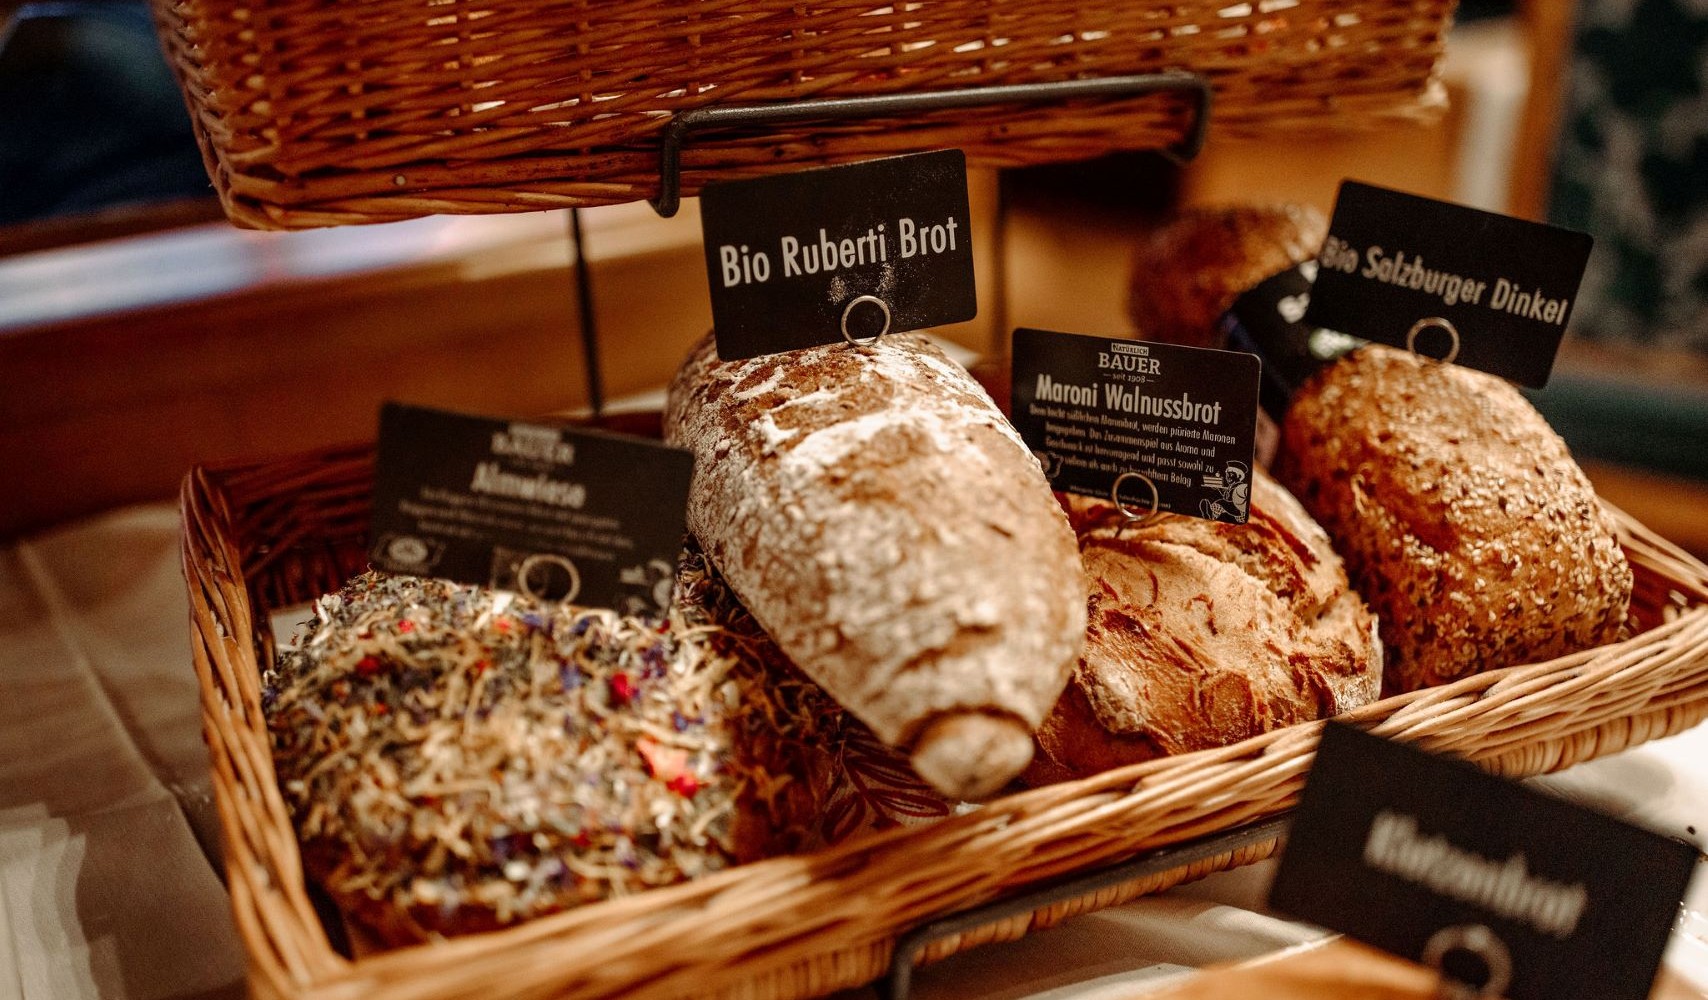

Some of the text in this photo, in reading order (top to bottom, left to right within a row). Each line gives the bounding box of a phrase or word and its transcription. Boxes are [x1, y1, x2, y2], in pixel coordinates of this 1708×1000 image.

[720, 216, 958, 287] Bio Ruberti Brot
[1362, 245, 1487, 306] Salzburger
[1490, 278, 1569, 326] Dinkel
[1098, 352, 1161, 375] BAUER
[1112, 373, 1146, 383] seit 1908
[1035, 374, 1222, 425] Maroni Walnussbrot
[1142, 422, 1168, 434] werden
[1170, 426, 1201, 440] pürierte
[1202, 428, 1236, 445] Maronen
[1160, 440, 1173, 451] aus
[1175, 440, 1199, 455] Aroma
[1200, 446, 1216, 458] und
[1141, 453, 1156, 464] und
[1157, 456, 1176, 468] passt
[1178, 459, 1204, 473] sowohl
[1205, 464, 1214, 473] zu
[1170, 472, 1192, 488] Belag
